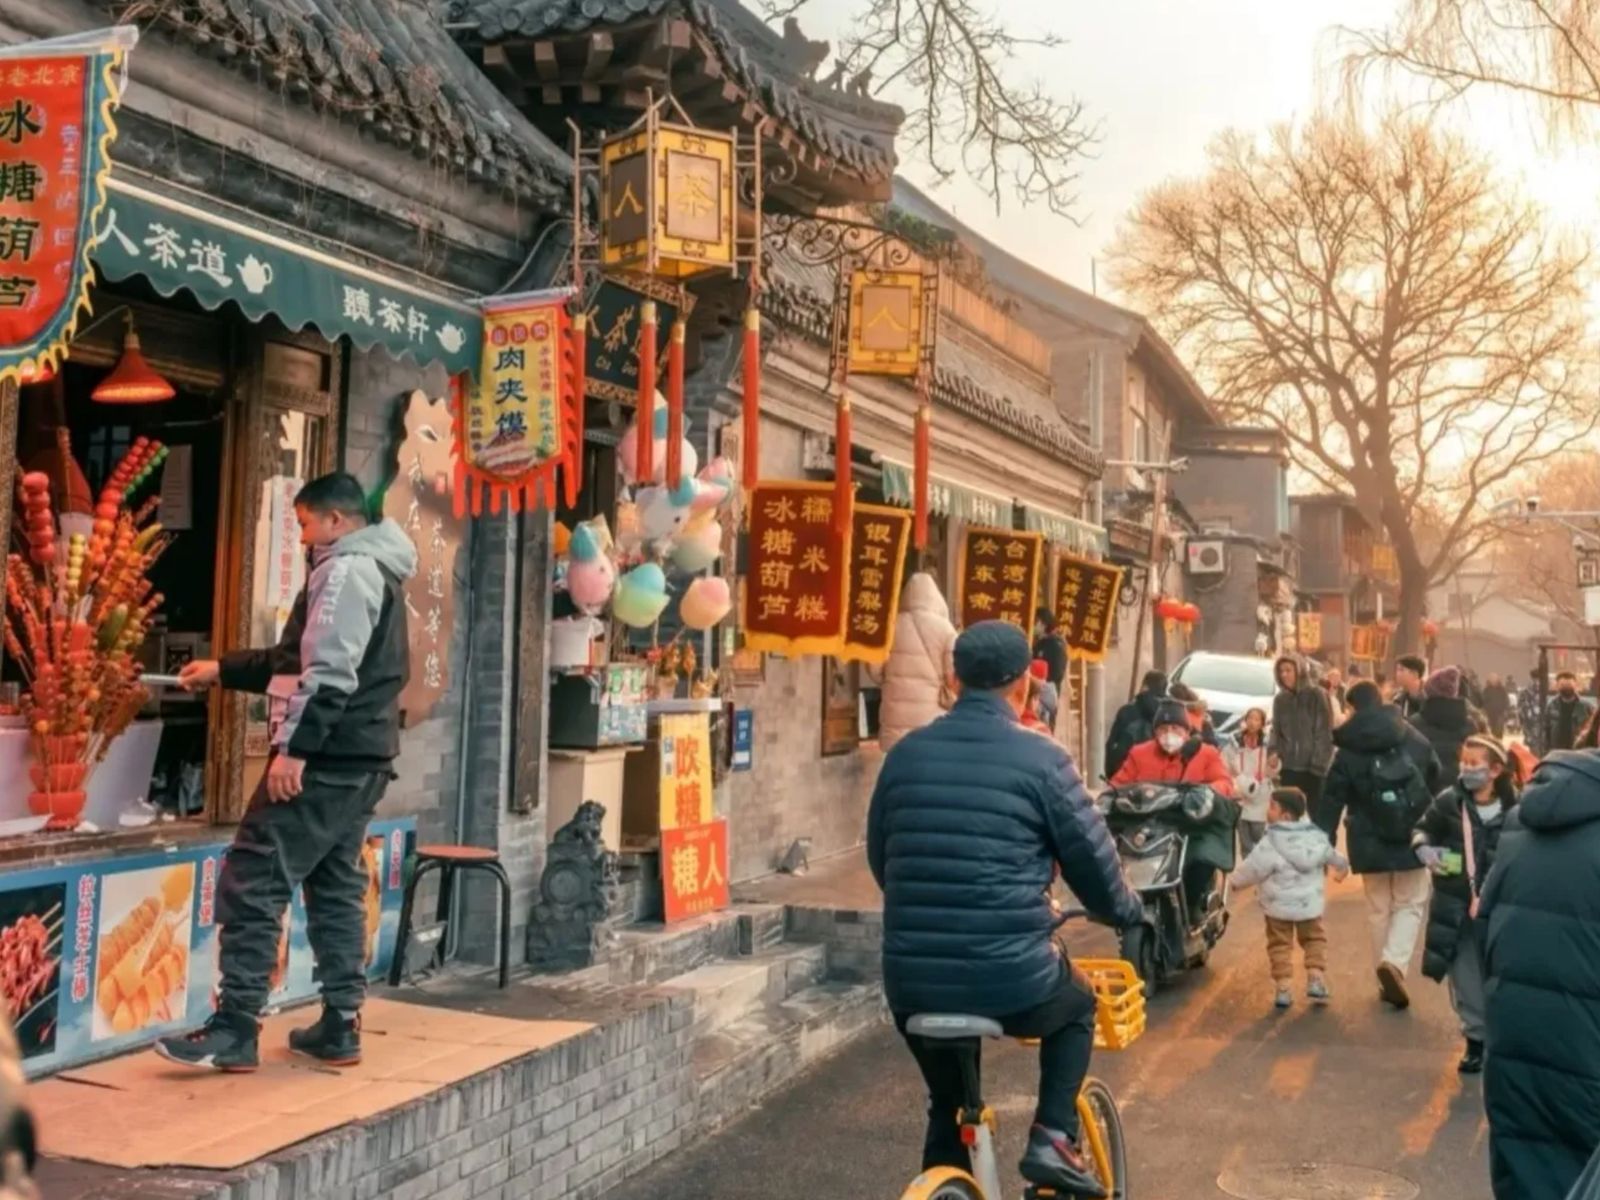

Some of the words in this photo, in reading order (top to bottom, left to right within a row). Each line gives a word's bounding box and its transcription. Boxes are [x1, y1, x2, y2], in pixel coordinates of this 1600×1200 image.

[0, 64, 80, 87] 老北京
[0, 100, 42, 308] 冰糖葫芦
[614, 180, 644, 218] 人
[94, 208, 233, 288] 人茶道
[867, 303, 908, 332] 人
[492, 346, 528, 437] 肉夹馍
[758, 496, 797, 621] 冰糖葫芦
[794, 496, 833, 622] 糯米糕
[852, 521, 892, 636] 银耳雪梨汤
[674, 735, 703, 827] 吹糖
[671, 841, 724, 898] 糖人
